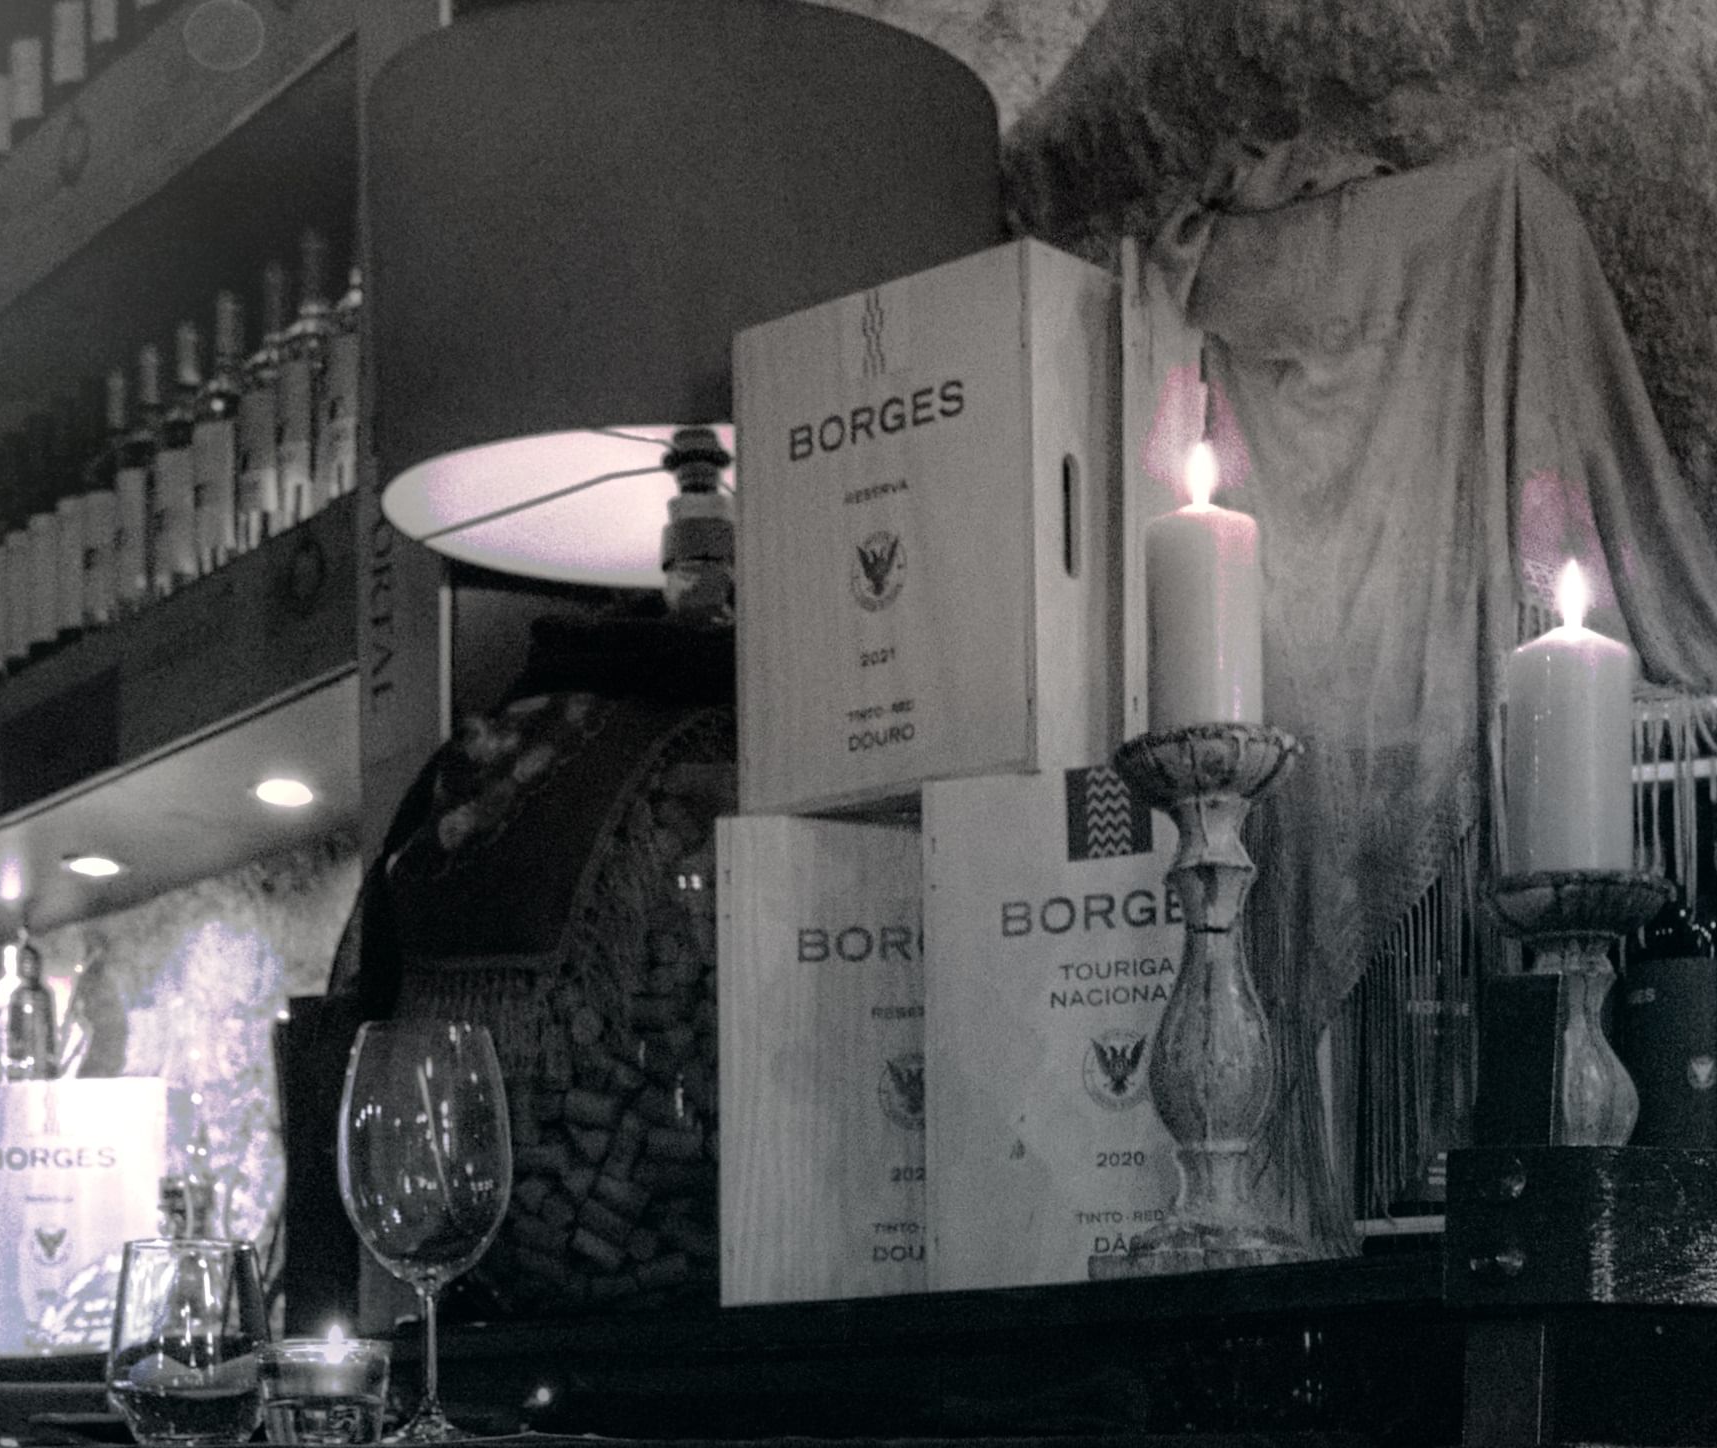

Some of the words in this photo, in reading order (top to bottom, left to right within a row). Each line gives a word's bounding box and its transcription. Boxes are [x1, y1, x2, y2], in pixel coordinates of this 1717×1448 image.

[789, 379, 965, 462] BORGES
[371, 513, 394, 711] ORTAL
[848, 722, 916, 752] DOURO
[1001, 888, 1184, 937] BORGE
[797, 926, 924, 963] BOR
[1058, 957, 1175, 981] TOURIGA
[1050, 983, 1174, 1009] NACIONA
[1096, 1151, 1145, 1168] 2020
[890, 1166, 925, 1182] 202
[1074, 1210, 1124, 1224] TINTO
[1132, 1208, 1165, 1222] RED
[872, 1245, 925, 1262] DOU
